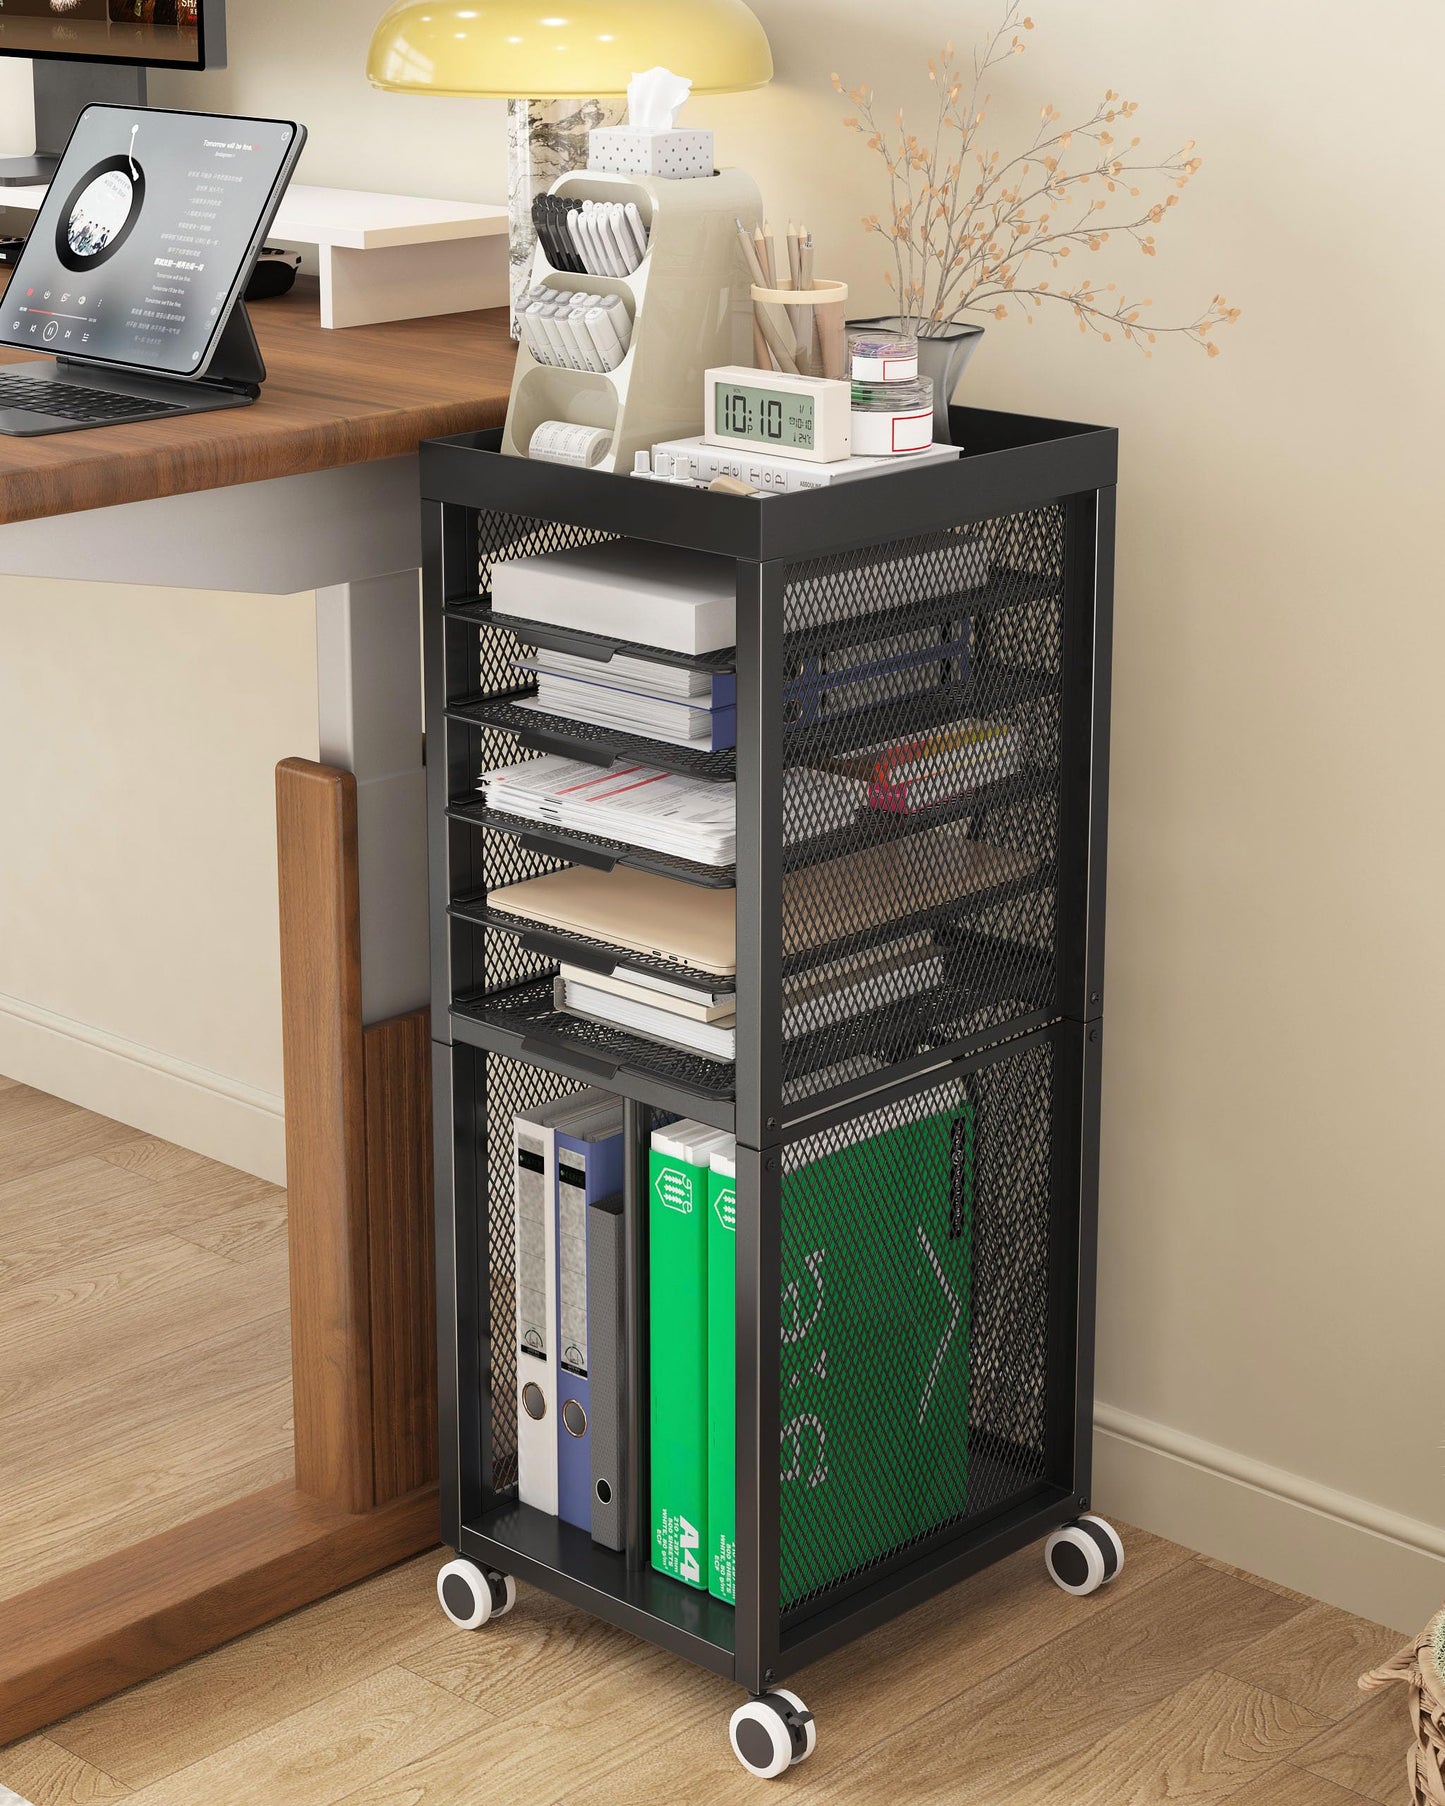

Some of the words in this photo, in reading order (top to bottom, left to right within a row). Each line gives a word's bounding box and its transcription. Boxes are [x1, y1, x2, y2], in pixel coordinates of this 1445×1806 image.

[725, 394, 782, 439] 10:10
[747, 424, 753, 434] P
[796, 418, 812, 431] 10:10
[680, 1514, 700, 1583] A4
